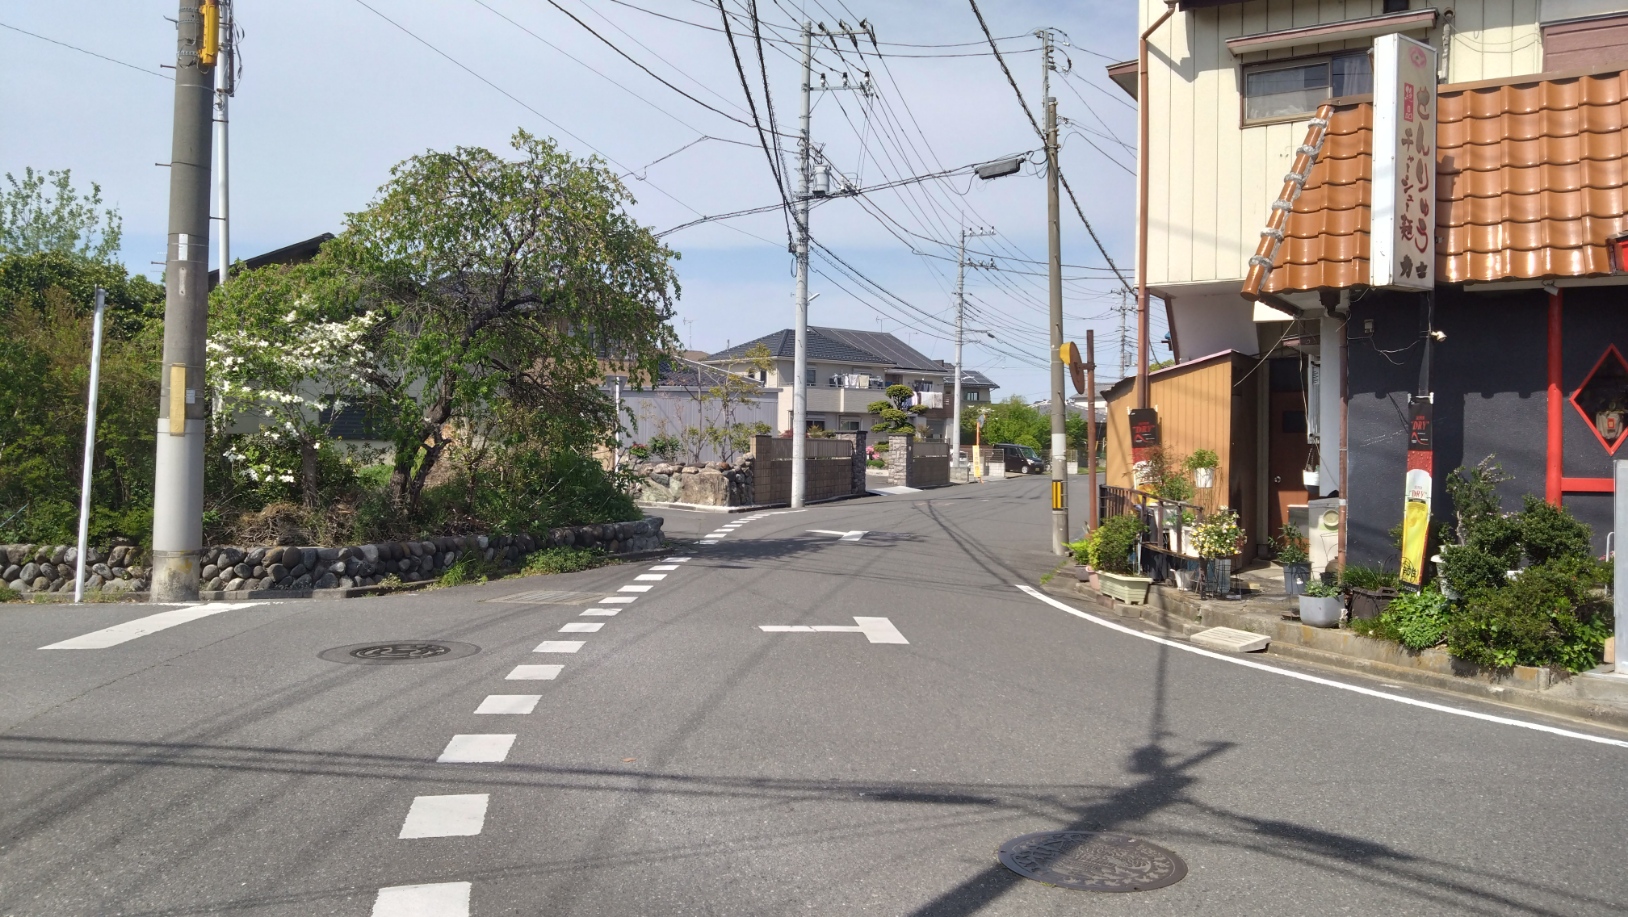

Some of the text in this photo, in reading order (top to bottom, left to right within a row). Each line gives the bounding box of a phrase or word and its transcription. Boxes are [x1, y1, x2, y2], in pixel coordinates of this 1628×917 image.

[1400, 127, 1414, 241] チャーシュー麺
[1415, 86, 1430, 254] せんりゅう
